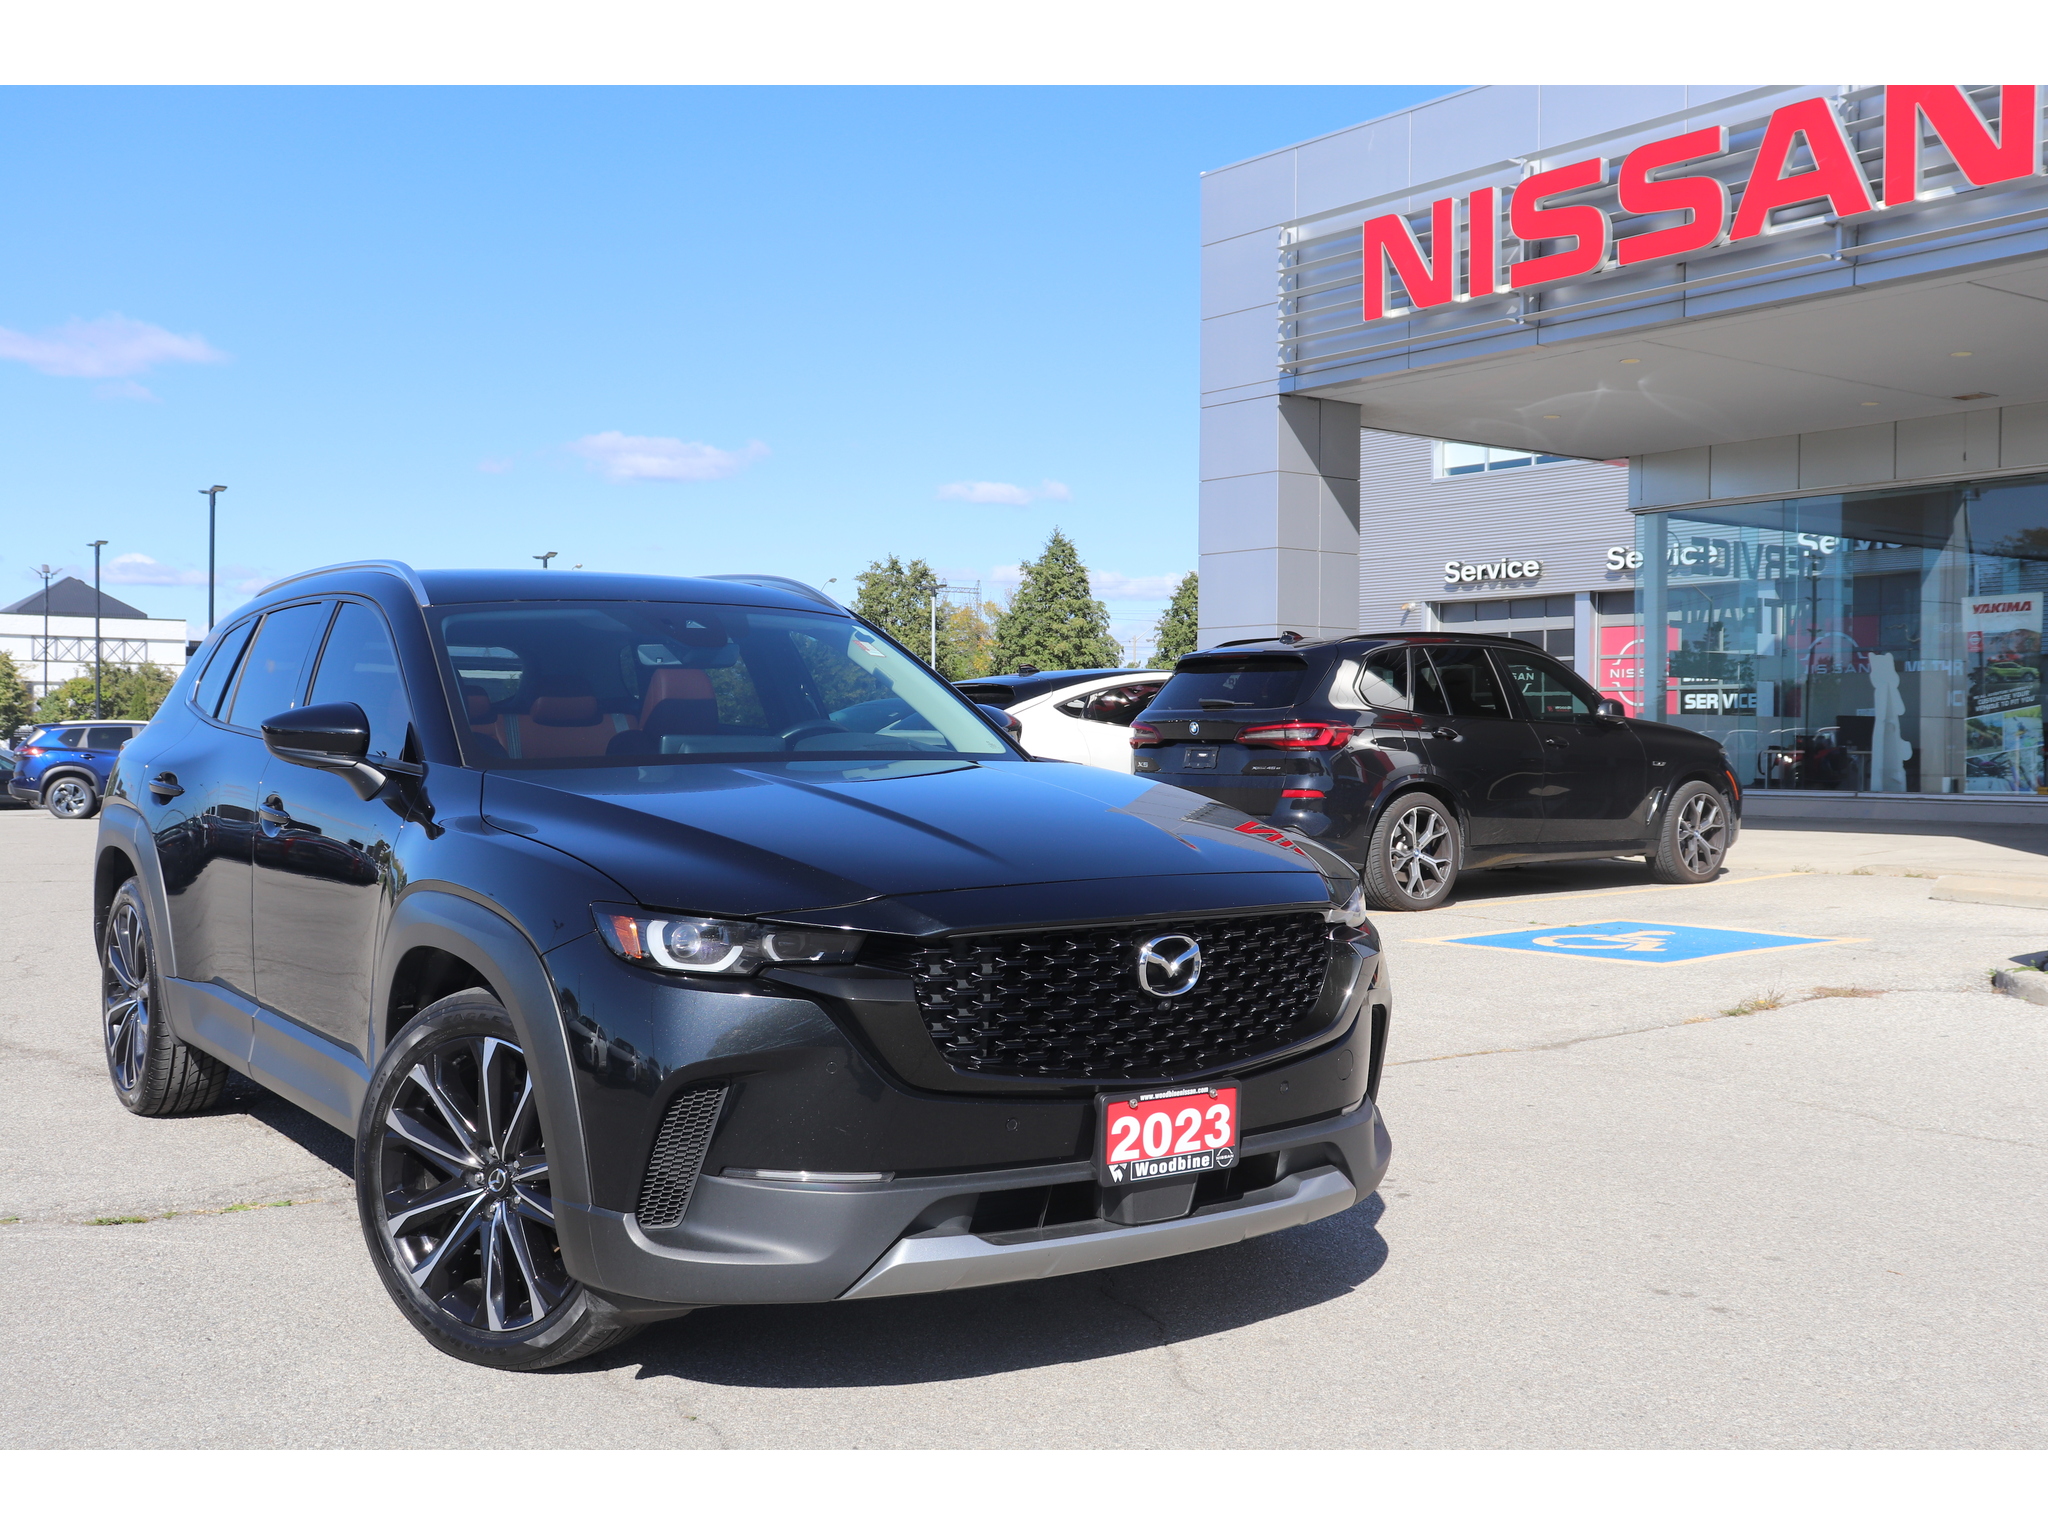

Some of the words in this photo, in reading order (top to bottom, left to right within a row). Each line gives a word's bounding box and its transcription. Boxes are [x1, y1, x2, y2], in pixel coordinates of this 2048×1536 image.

[1363, 85, 2036, 321] NISSAN
[1605, 543, 1718, 570] Seice
[1444, 558, 1540, 583] Service
[1972, 601, 2032, 614] YAKIMA
[1684, 693, 1757, 710] SERVICE
[1140, 1087, 1209, 1101] www.woodbinenissan.com
[1111, 1104, 1231, 1162] 2023
[1136, 1155, 1210, 1177] Woodbine
